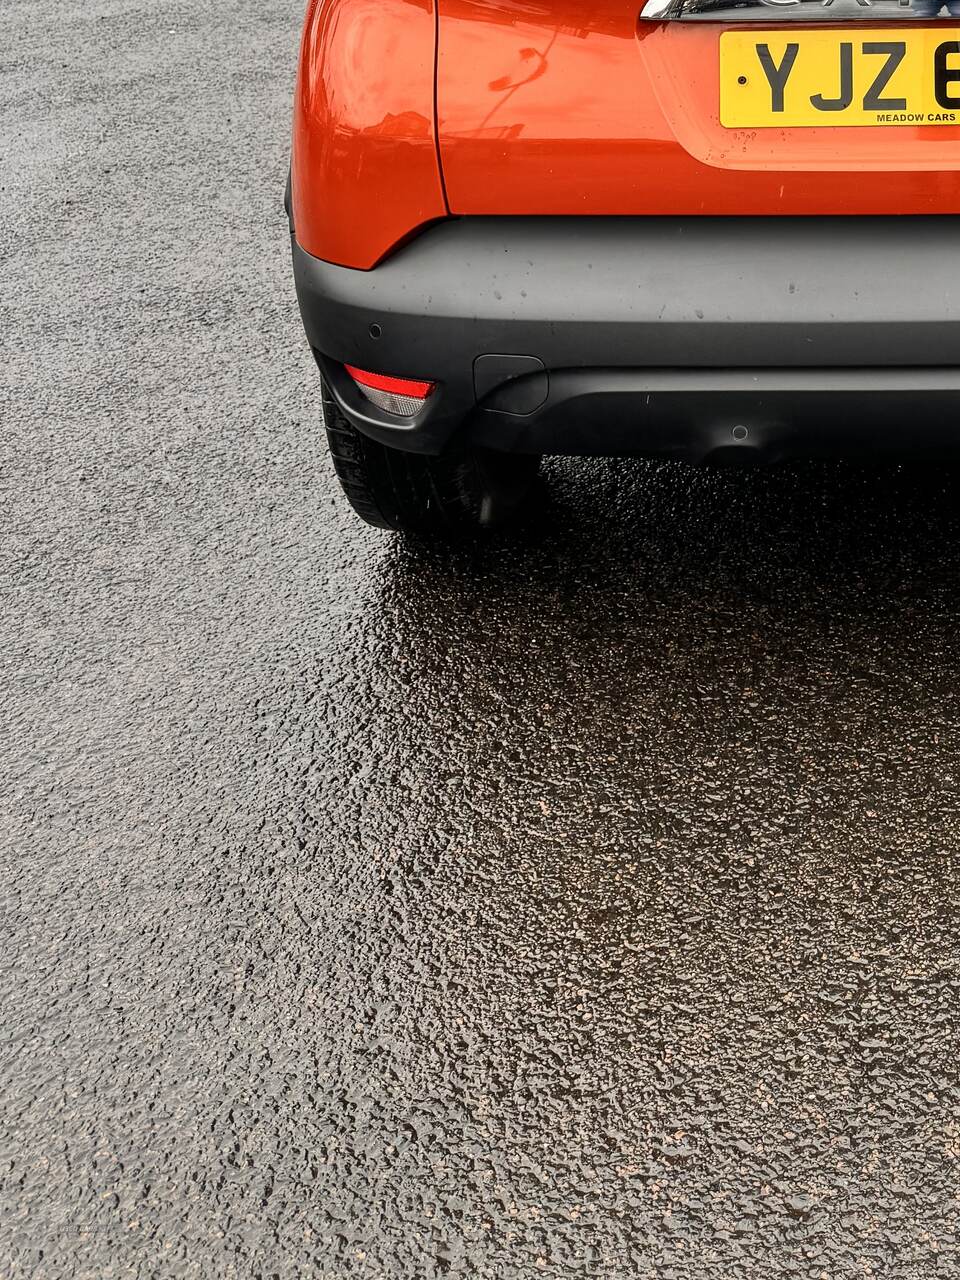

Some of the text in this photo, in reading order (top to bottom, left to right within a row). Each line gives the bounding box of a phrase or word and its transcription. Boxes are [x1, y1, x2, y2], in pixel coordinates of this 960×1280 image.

[756, 41, 907, 112] YJZ
[877, 114, 924, 122] MEADOW
[928, 113, 956, 122] CARS
